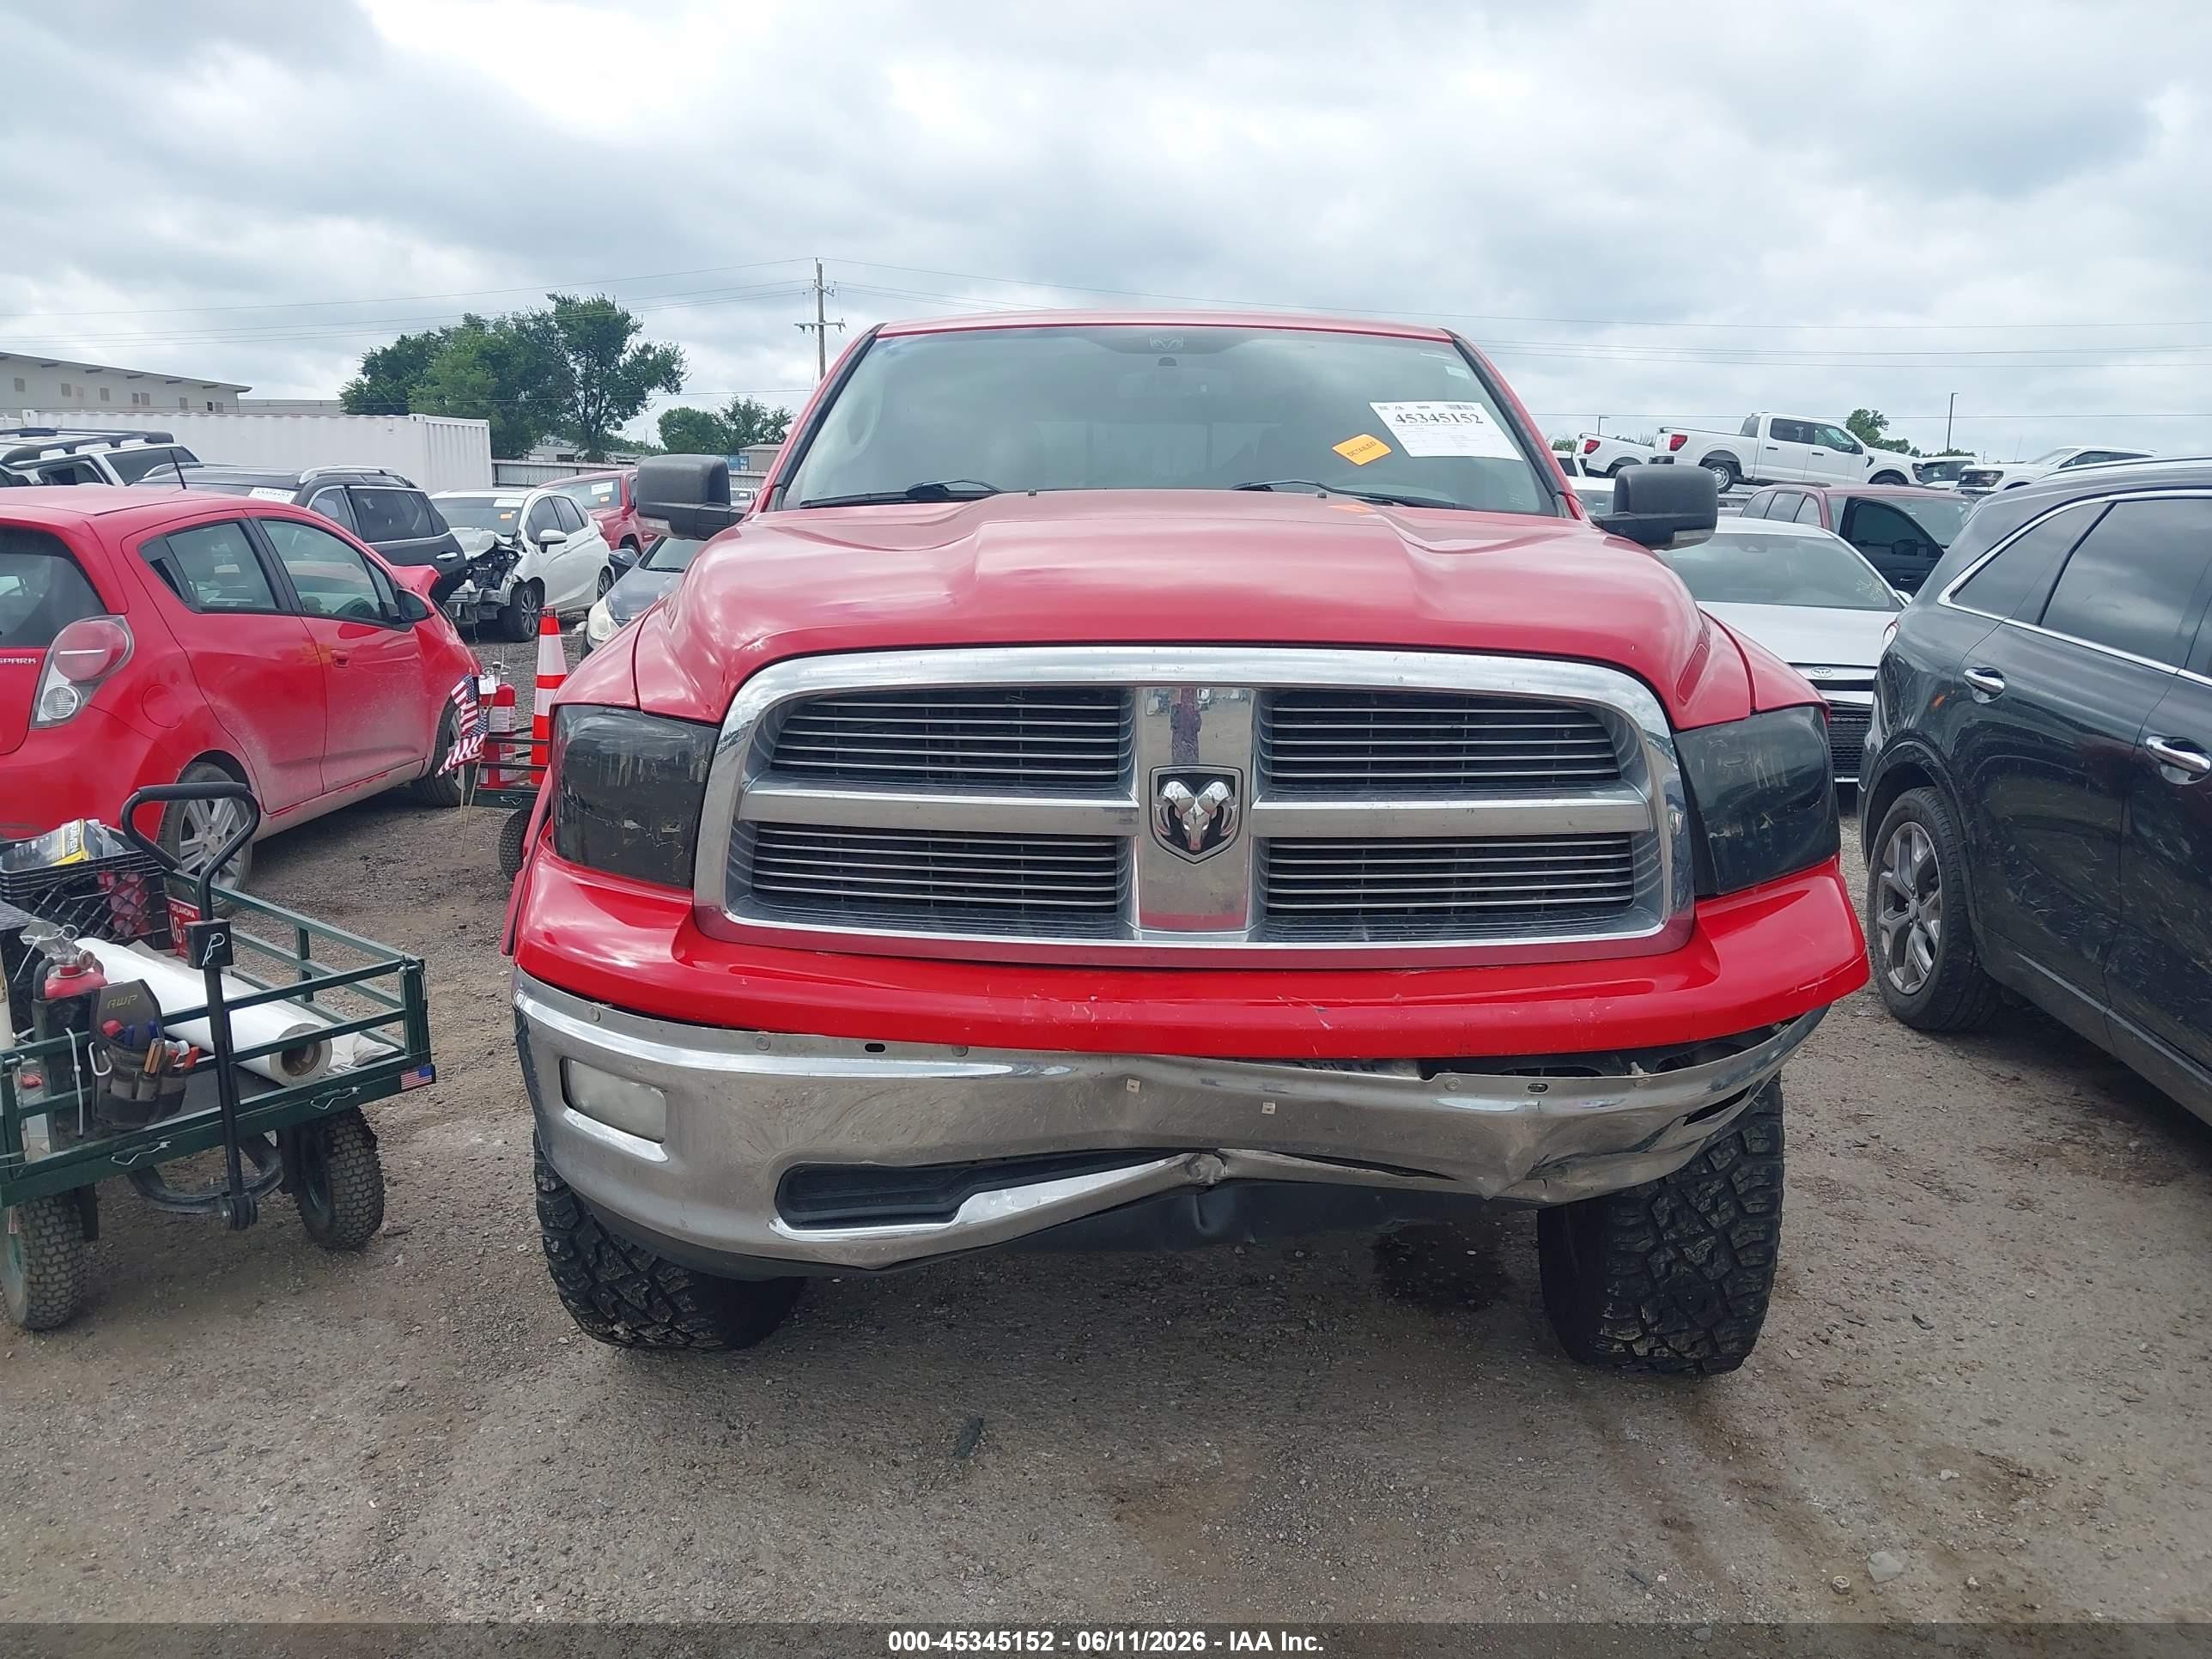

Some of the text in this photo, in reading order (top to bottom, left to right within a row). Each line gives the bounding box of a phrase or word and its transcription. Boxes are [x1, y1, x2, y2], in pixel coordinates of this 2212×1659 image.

[1395, 413, 1484, 424] 45345152
[1346, 441, 1377, 457] DETAILED
[171, 902, 196, 918] OKLAHOMA
[106, 994, 138, 1009] AWP
